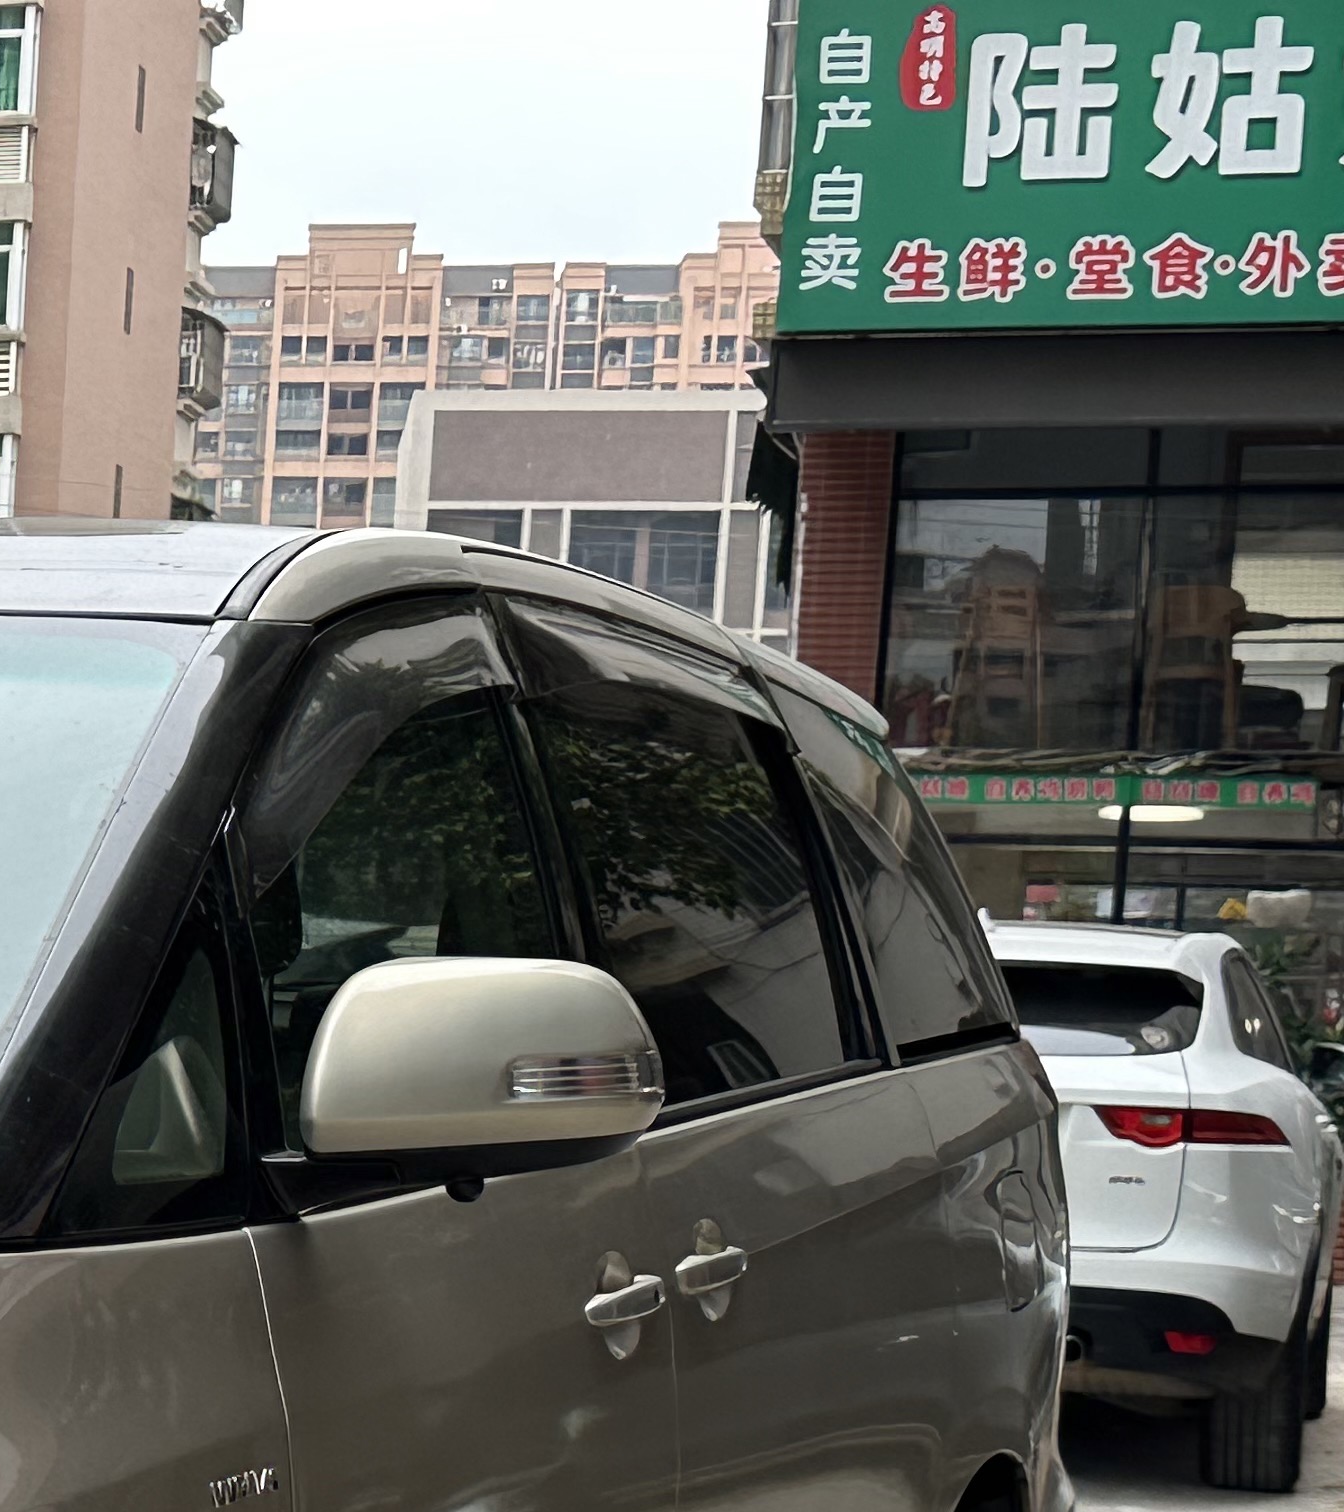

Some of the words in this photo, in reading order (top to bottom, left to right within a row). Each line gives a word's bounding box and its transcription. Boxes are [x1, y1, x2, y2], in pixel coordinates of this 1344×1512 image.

[798, 28, 872, 291] 自产自卖
[962, 16, 1344, 188] 陆姑
